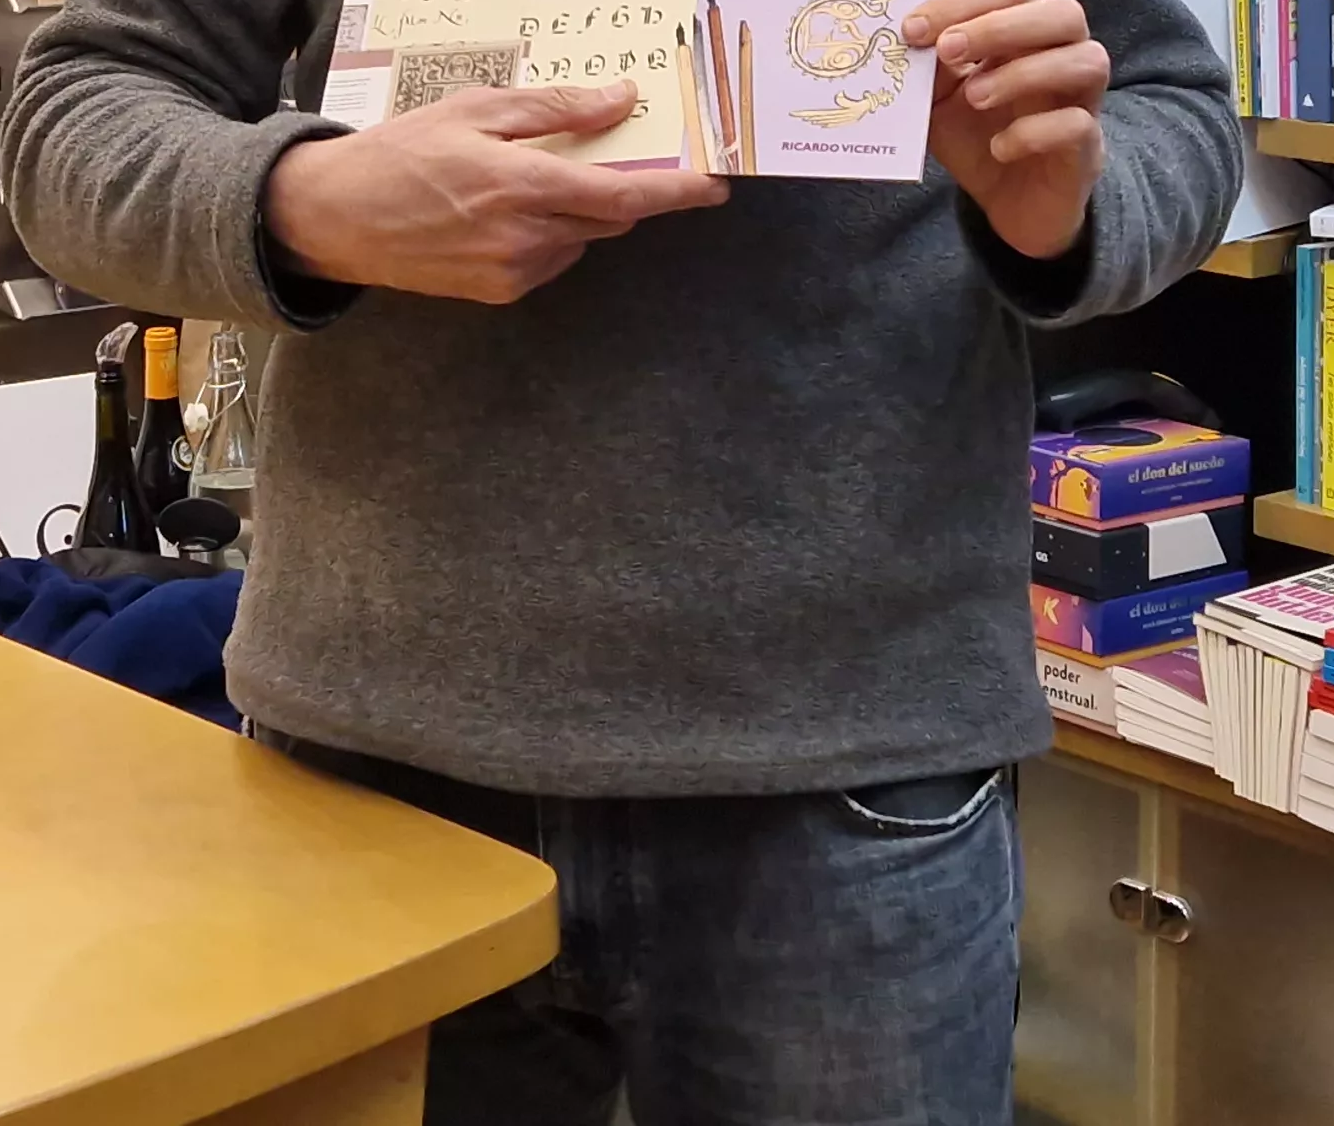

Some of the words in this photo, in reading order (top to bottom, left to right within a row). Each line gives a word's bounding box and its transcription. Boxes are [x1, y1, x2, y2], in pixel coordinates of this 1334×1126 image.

[781, 141, 840, 154] RICARDO
[841, 142, 899, 156] VICENTE
[1142, 465, 1166, 481] don
[1168, 460, 1189, 478] del
[1043, 662, 1082, 685] poder
[1042, 685, 1099, 711] enstrual.
